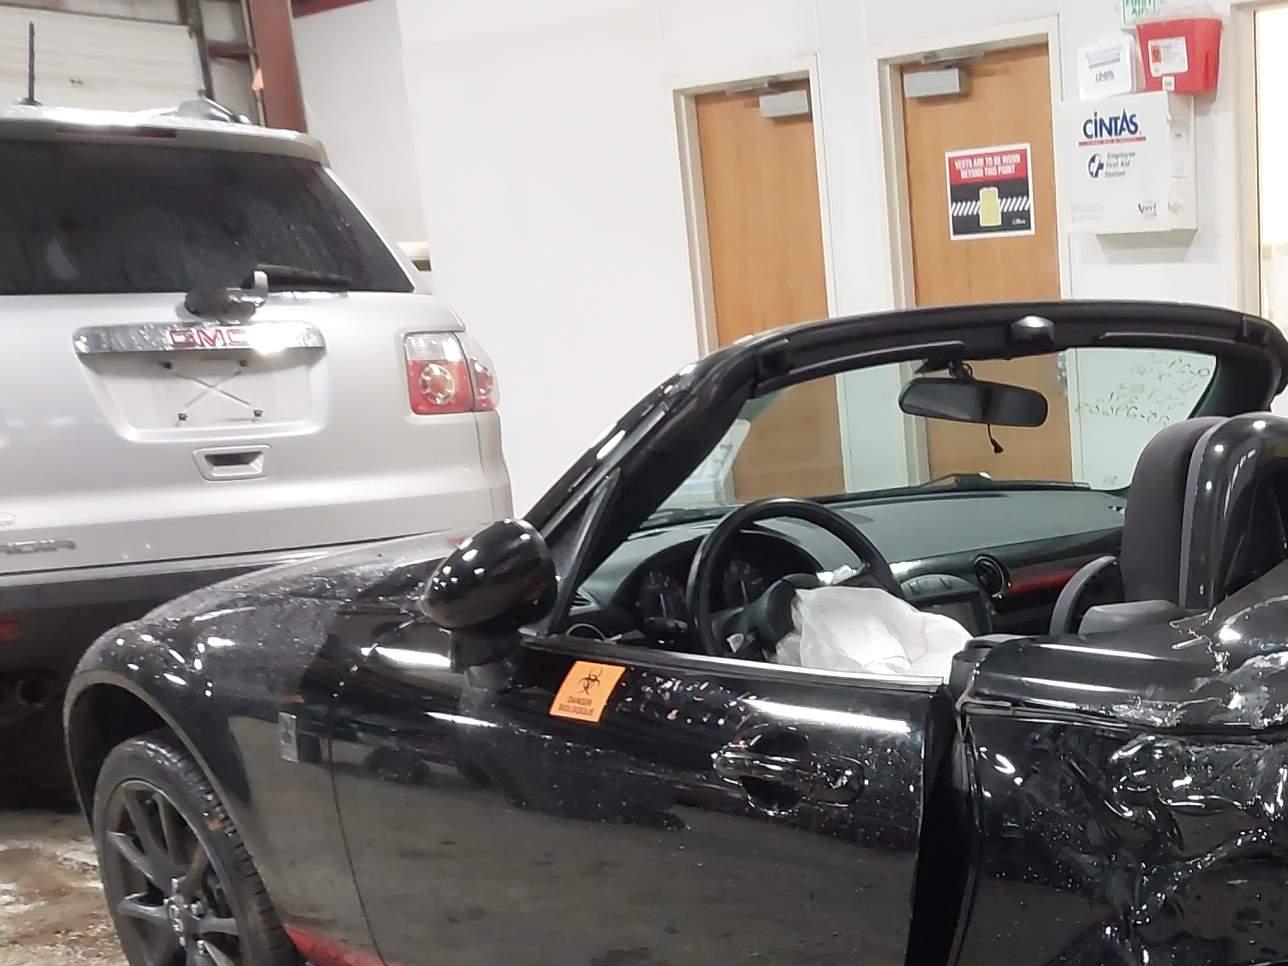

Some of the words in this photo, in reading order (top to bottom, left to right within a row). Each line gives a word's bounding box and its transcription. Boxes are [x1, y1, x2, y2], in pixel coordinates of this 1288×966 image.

[1082, 108, 1139, 139] CINTAS
[1107, 151, 1136, 160] Employee
[985, 156, 993, 167] TO
[1105, 160, 1119, 169] First
[1120, 159, 1131, 168] Aid
[984, 166, 997, 176] THIS
[997, 164, 1016, 175] POINT
[1104, 170, 1126, 178] Station
[169, 328, 248, 348] GMC
